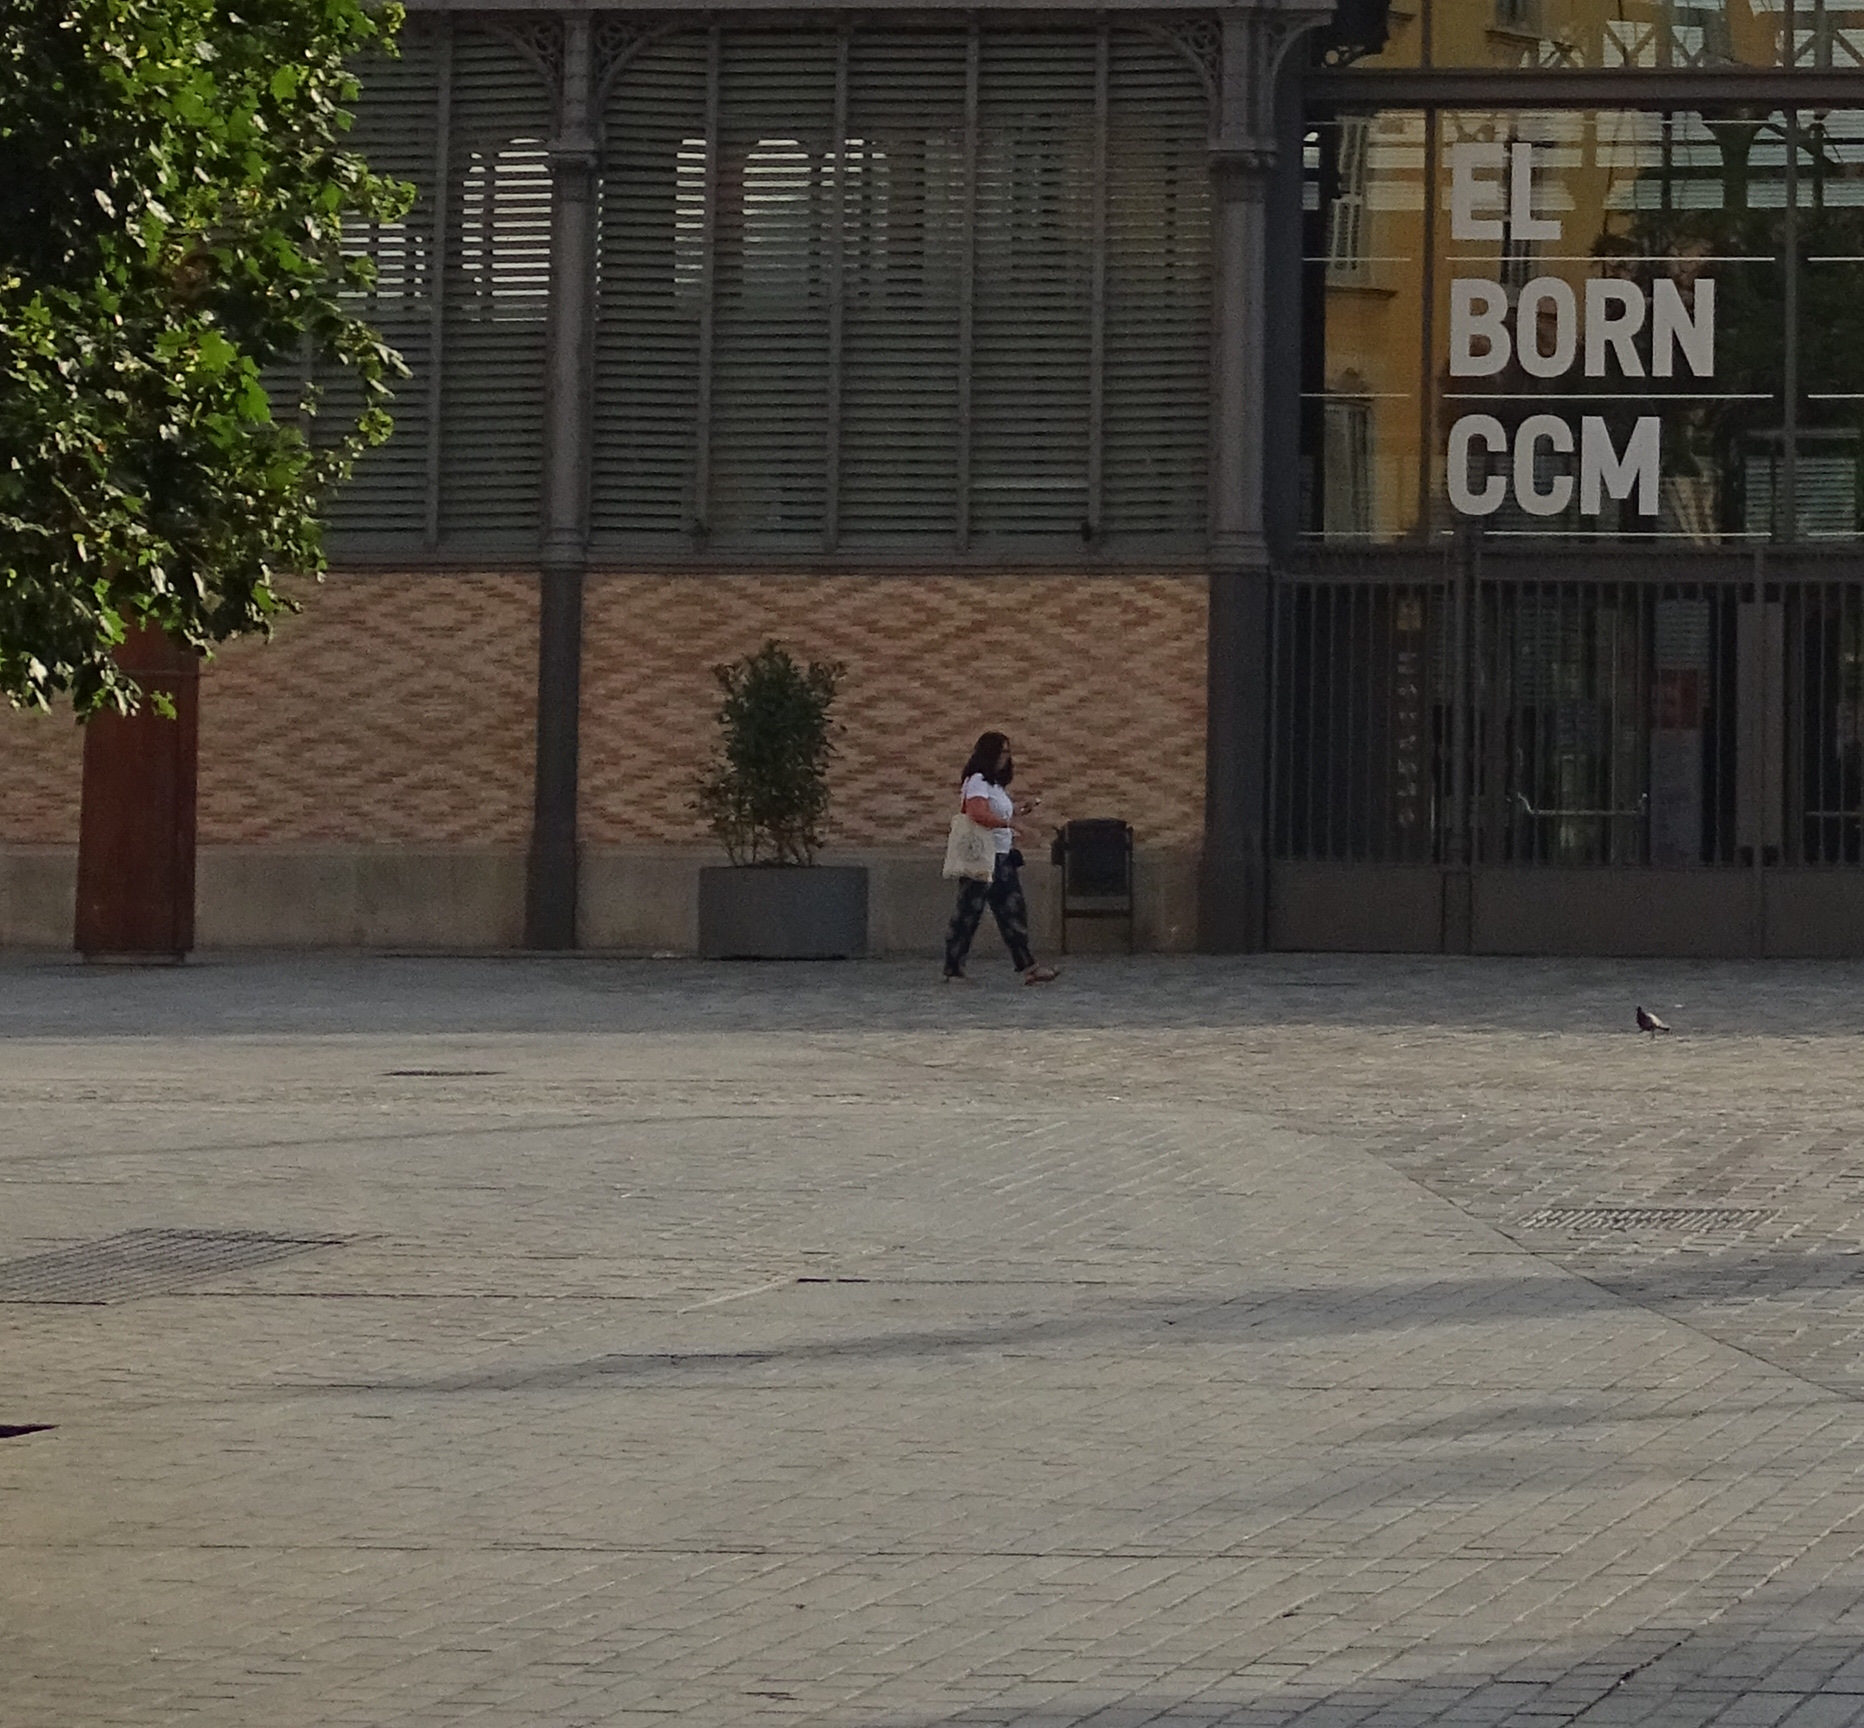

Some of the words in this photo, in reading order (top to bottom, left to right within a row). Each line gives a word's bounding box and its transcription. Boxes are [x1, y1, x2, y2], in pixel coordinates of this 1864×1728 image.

[1451, 142, 1562, 241] EL
[1449, 276, 1715, 378] BORN
[1446, 413, 1661, 517] CCM
